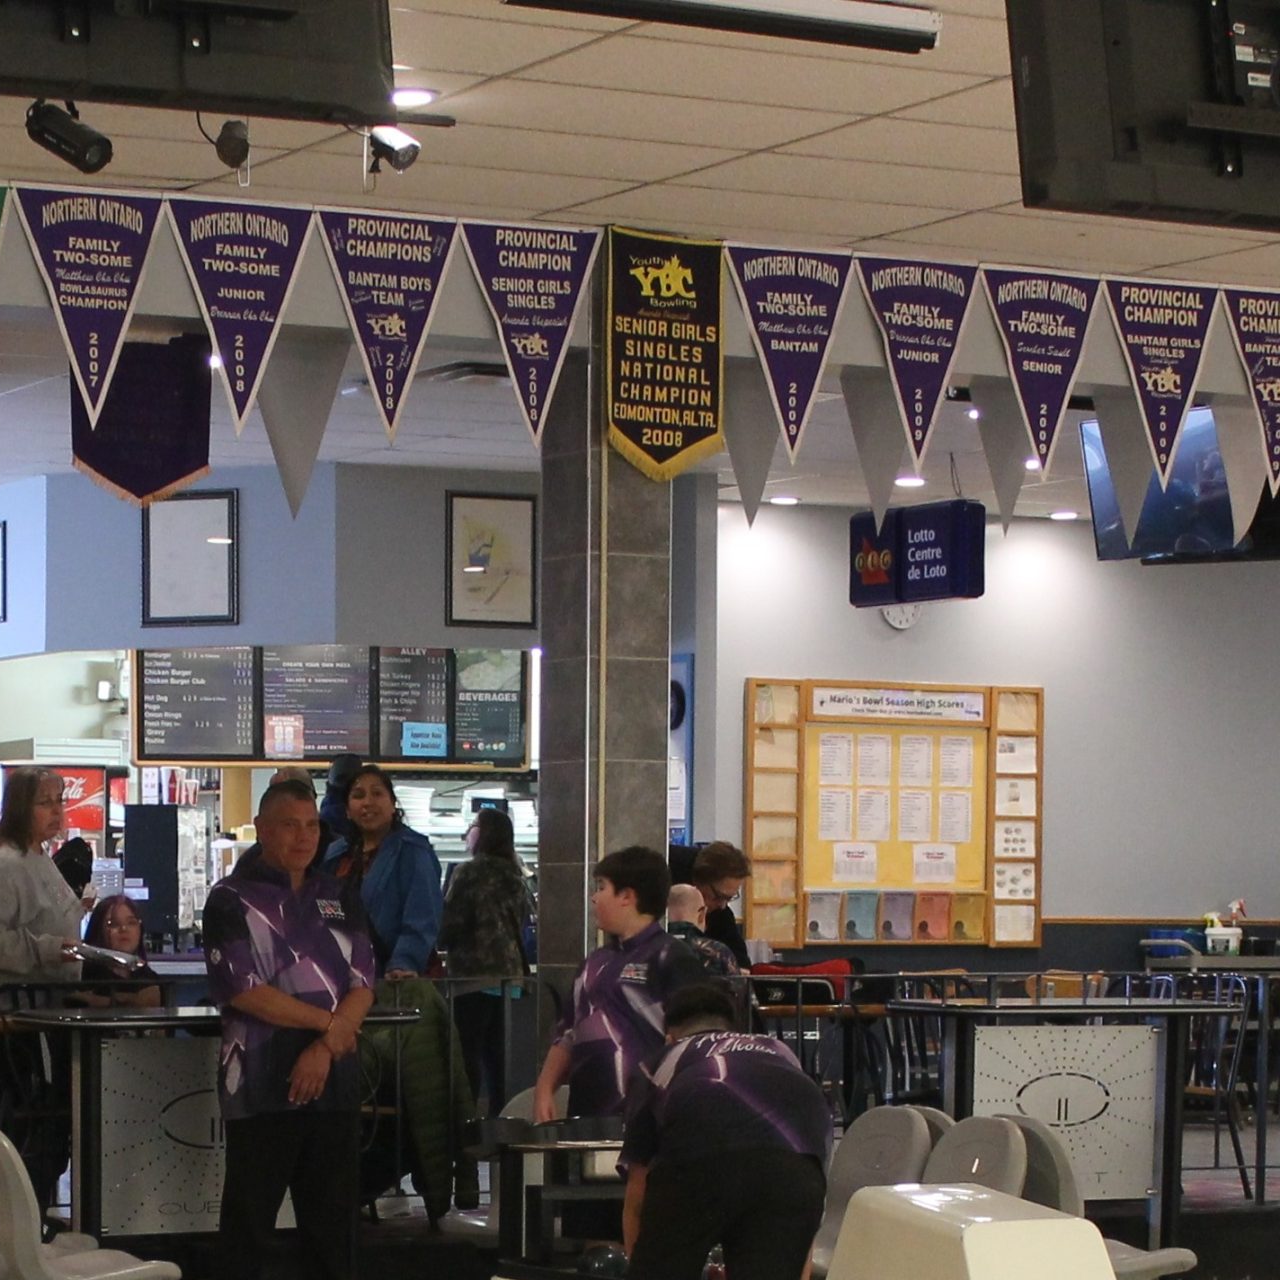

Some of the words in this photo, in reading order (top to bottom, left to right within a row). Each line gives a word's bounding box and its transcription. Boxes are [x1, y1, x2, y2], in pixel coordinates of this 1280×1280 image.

[42, 199, 97, 228] NORTHERN
[99, 200, 143, 235] ONTARIO
[190, 212, 243, 243] NORTHERN
[245, 214, 289, 247] ONTARIO
[348, 218, 433, 242] PROVINCIAL
[69, 237, 121, 252] FAMILY
[496, 229, 577, 251] PROVINCIAL
[53, 250, 133, 267] TWO-SOME
[216, 243, 267, 259] FAMILY
[346, 239, 432, 263] CHAMPIONS
[629, 254, 664, 265] Youth
[202, 258, 280, 277] TWO-SOME
[498, 253, 571, 272] CHAMPION
[744, 256, 795, 282] NORTHERN
[798, 257, 839, 288] ONTARIO
[59, 283, 128, 297] BOWLASAURUS
[348, 271, 397, 289] BANTAM
[400, 276, 432, 292] BOYS
[492, 278, 534, 293] SENIOR
[537, 279, 571, 294] GIRLS
[629, 266, 696, 298] YBC
[872, 267, 922, 292] NORTHERN
[924, 268, 965, 298] ONTARIO
[59, 295, 128, 310] CHAMPION
[217, 288, 265, 301] JUNIOR
[372, 291, 404, 305] TEAM
[507, 294, 555, 309] SINGLES
[650, 298, 697, 308] Bowling
[767, 292, 813, 305] FAMILY
[998, 280, 1048, 305] NORTHERN
[1050, 282, 1087, 312] ONTARIO
[1121, 287, 1204, 310] PROVINCIAL
[756, 302, 827, 317] TWO-SOME
[894, 303, 941, 318] FAMILY
[1022, 310, 1065, 325] FAMILY
[1124, 306, 1198, 327] CHAMPION
[367, 319, 407, 337] YBC
[615, 316, 667, 335] SENIOR
[671, 322, 717, 343] GIRLS
[883, 312, 954, 331] TWO-SOME
[1008, 320, 1076, 338] TWO-SOME
[511, 338, 548, 356] YBC
[771, 340, 818, 353] BANTAM
[1127, 334, 1168, 347] BANTAM
[1170, 337, 1201, 349] GIRLS
[89, 332, 99, 387] 2007
[625, 339, 702, 363] SINGLES
[897, 349, 939, 363] JUNIOR
[1143, 346, 1185, 359] SINGLES
[235, 335, 244, 392] 2008
[620, 360, 710, 385] NATIONAL
[1023, 360, 1062, 375] SENIOR
[386, 354, 394, 410] 2008
[1141, 373, 1181, 394] YBC
[529, 368, 537, 420] 2008
[620, 381, 711, 406] CHAMPION
[789, 382, 797, 435] 2009
[915, 389, 923, 441] 2009
[642, 428, 683, 447] 2008
[1039, 404, 1047, 455] 2009
[908, 529, 935, 543] Lotto
[908, 547, 942, 562] Centre
[908, 566, 920, 580] de
[924, 564, 946, 578] Loto
[459, 693, 518, 702] BEVERAGES
[830, 695, 860, 704] Mario's
[886, 698, 915, 707] Season
[917, 699, 935, 708] High
[938, 700, 964, 708] Scores
